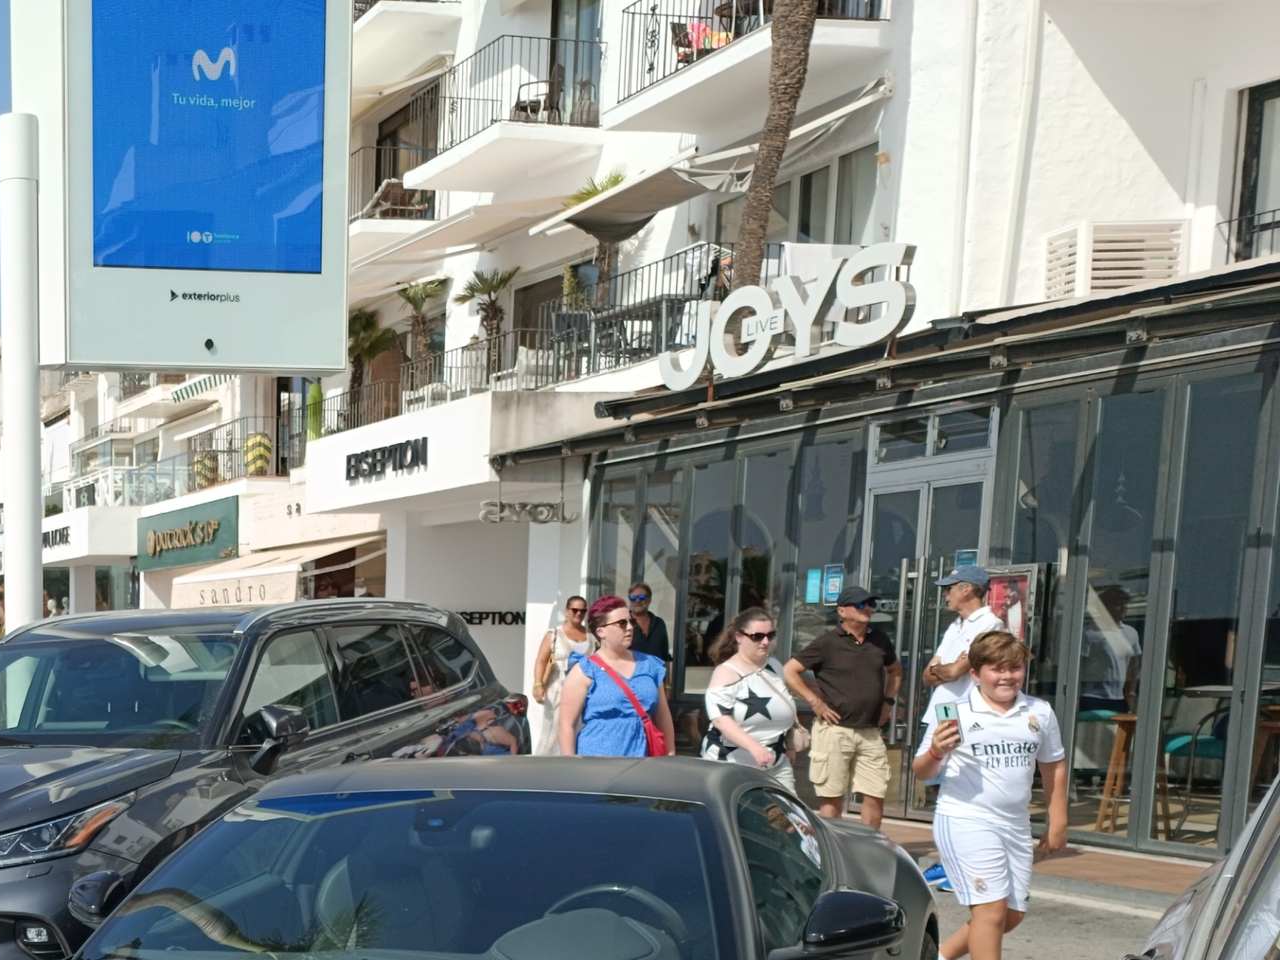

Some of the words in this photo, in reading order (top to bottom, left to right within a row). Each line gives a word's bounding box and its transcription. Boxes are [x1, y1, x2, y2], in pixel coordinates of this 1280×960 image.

[172, 93, 186, 105] Tu
[189, 94, 218, 108] vida,
[221, 97, 256, 110] mejor
[182, 291, 240, 303] exteriorplus
[658, 242, 917, 391] JOYS
[746, 315, 778, 337] LIVE
[199, 580, 266, 605] sandro
[986, 757, 1000, 769] FLY
